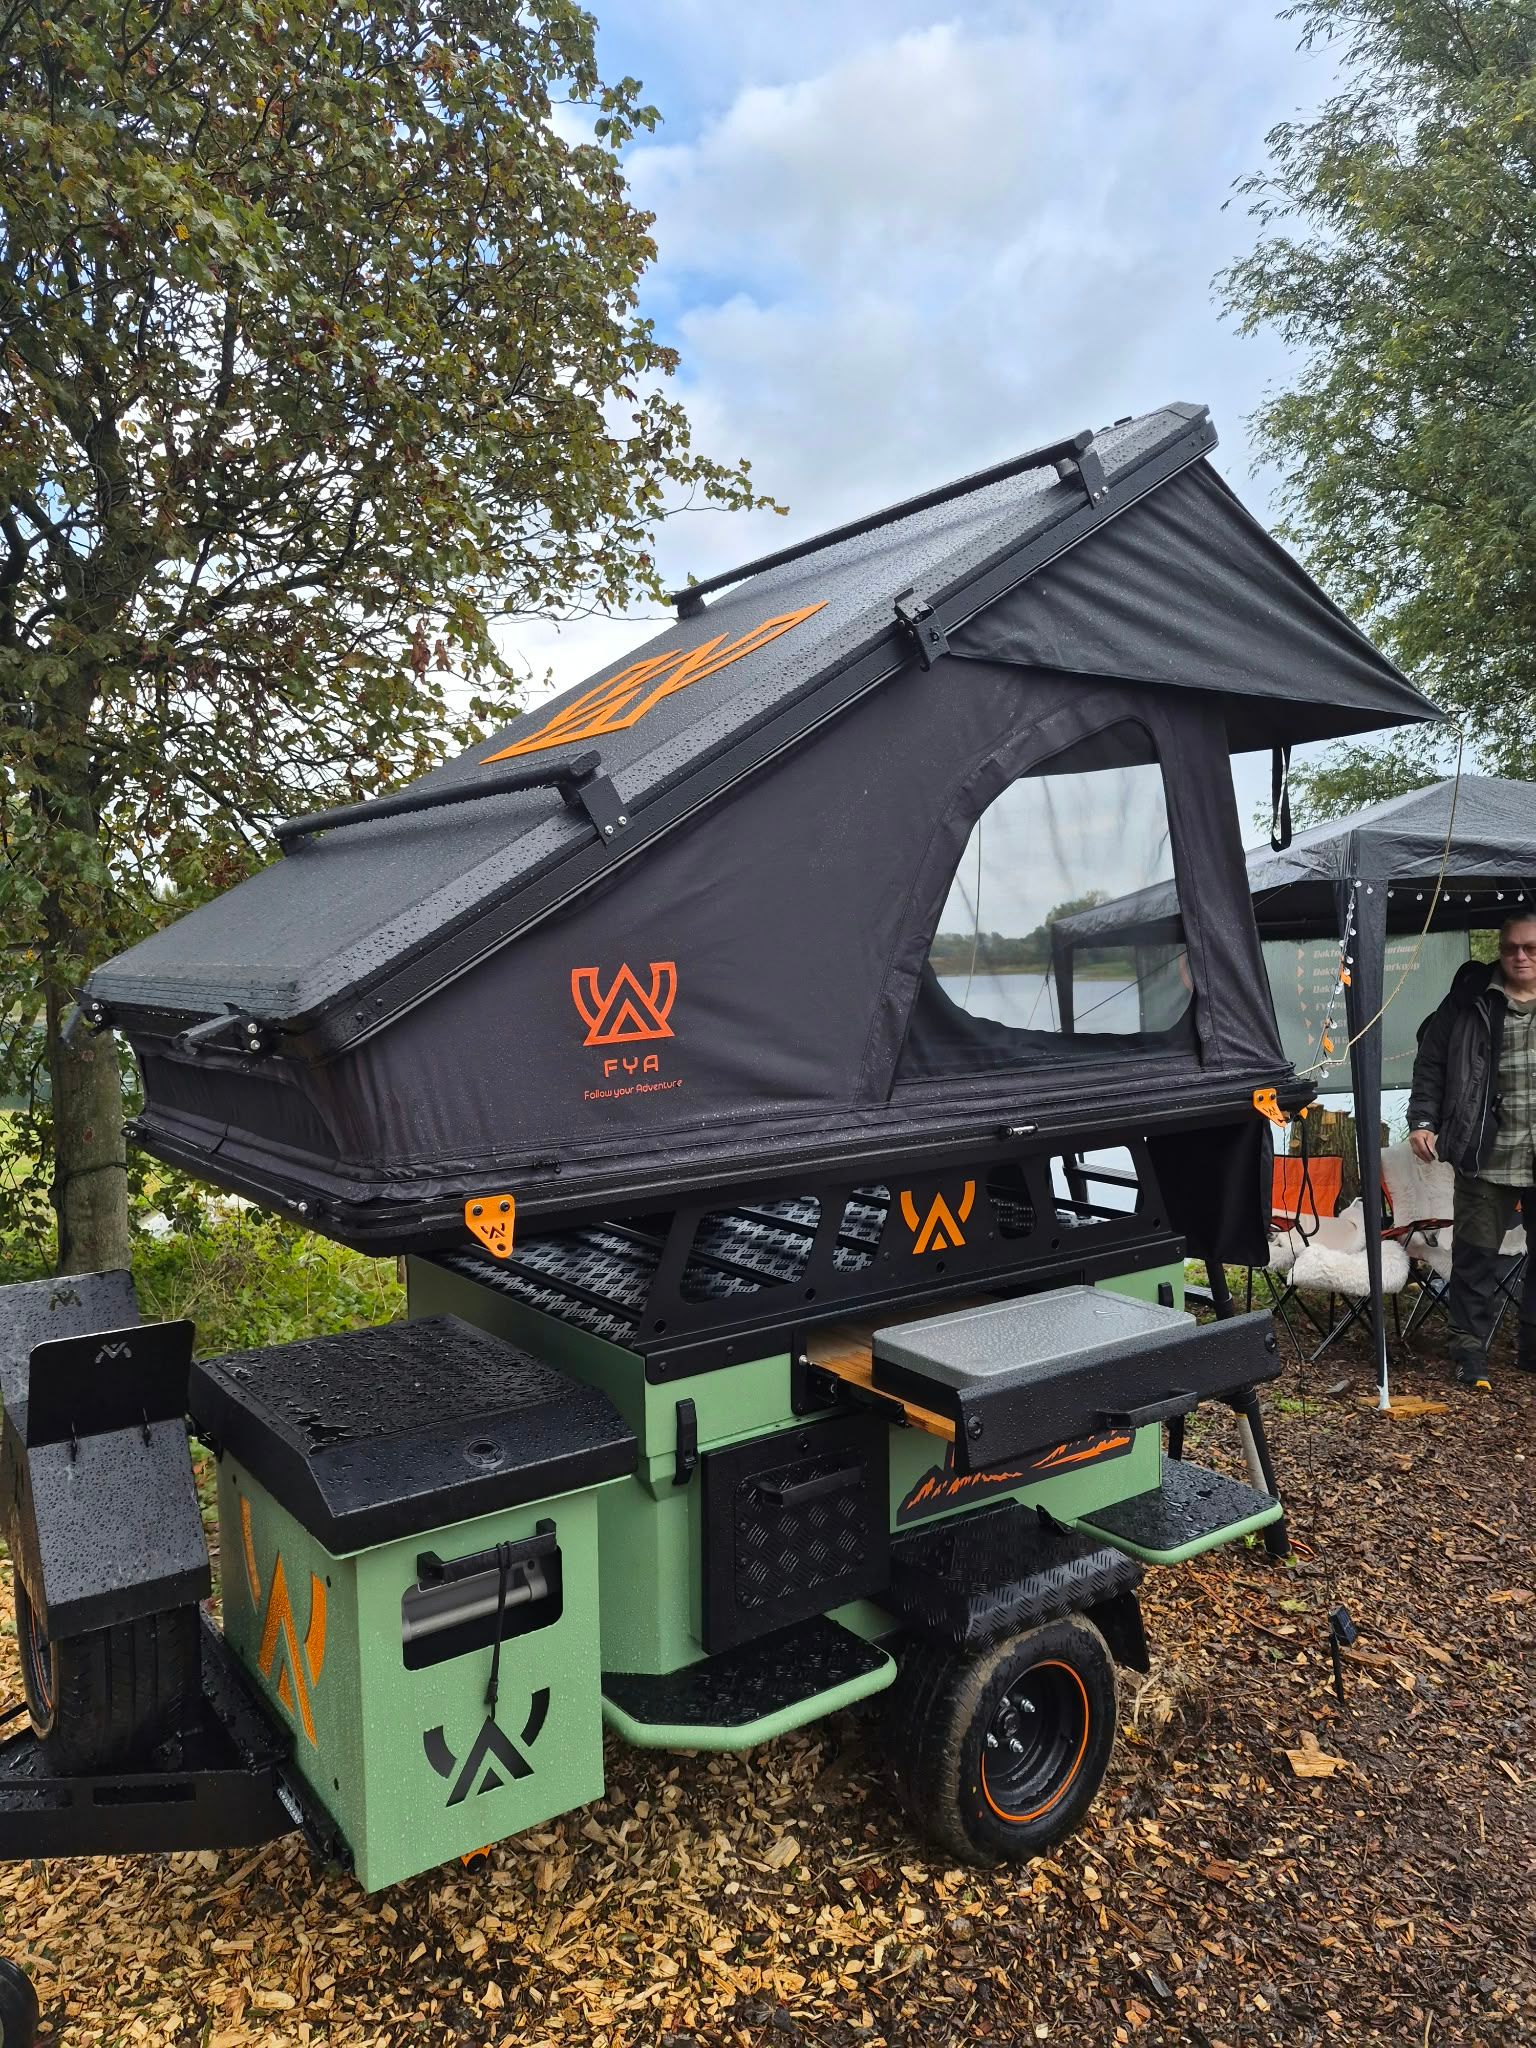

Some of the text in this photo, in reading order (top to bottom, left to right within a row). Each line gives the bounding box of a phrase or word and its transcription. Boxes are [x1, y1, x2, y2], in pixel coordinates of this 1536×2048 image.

[604, 1054, 659, 1078] FYA
[584, 1079, 683, 1100] Follow your Adventure
